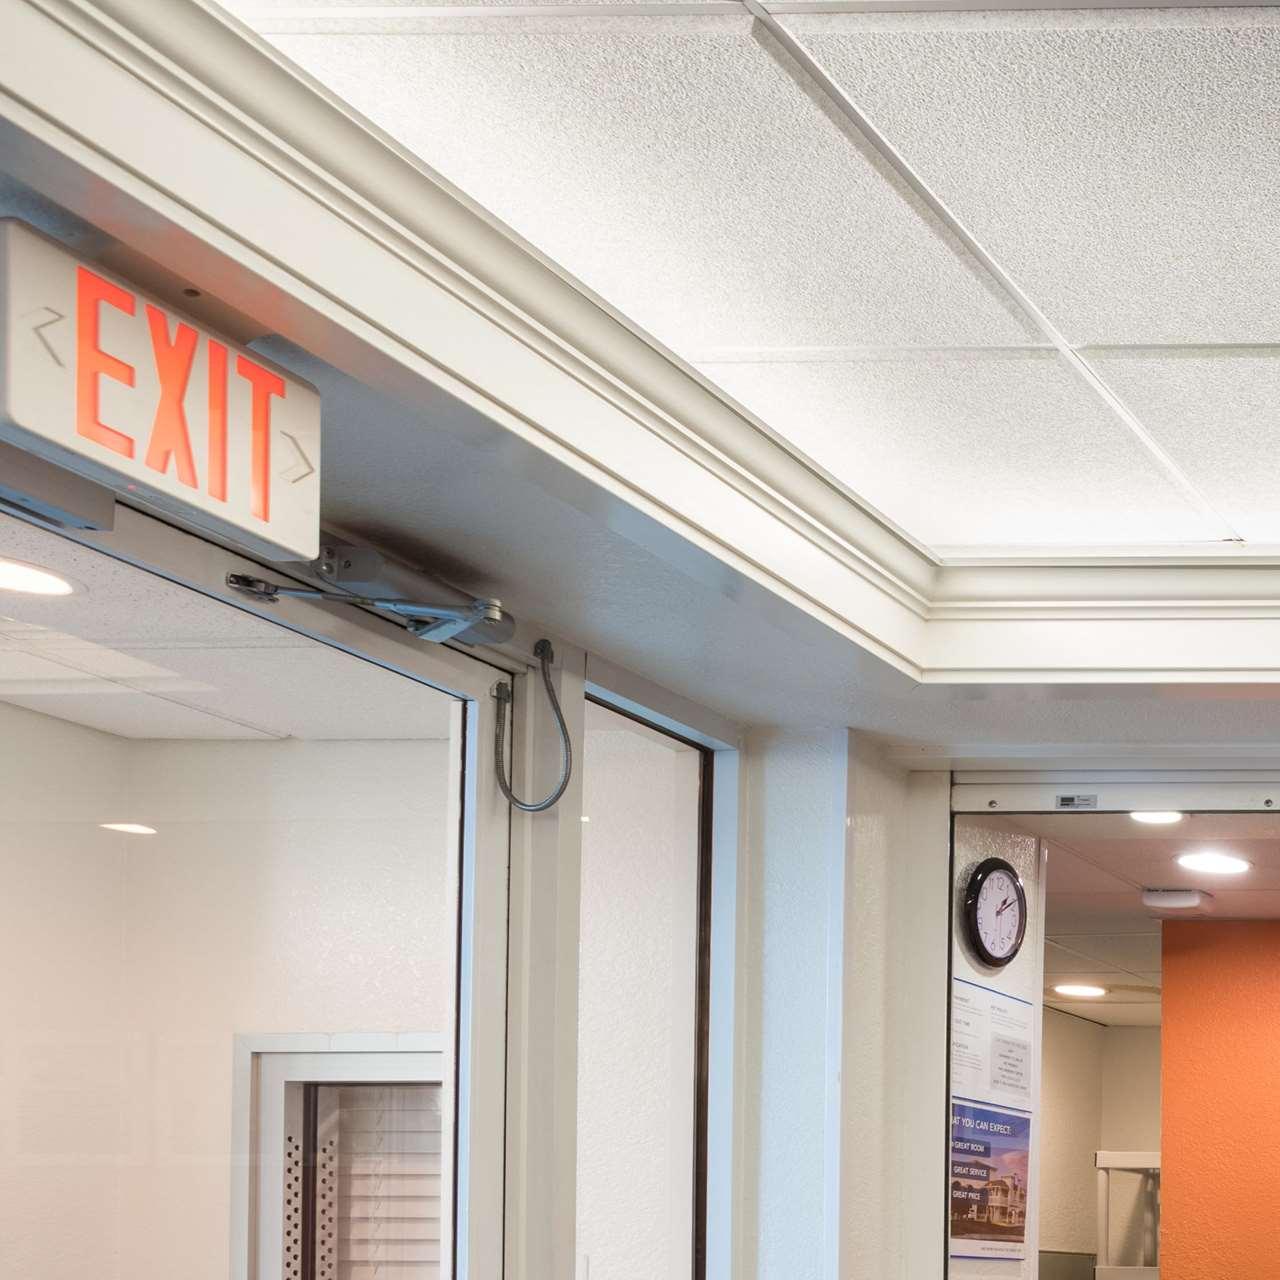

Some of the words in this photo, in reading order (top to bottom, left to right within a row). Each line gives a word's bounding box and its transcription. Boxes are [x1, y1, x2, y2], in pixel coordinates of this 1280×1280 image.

[76, 264, 287, 523] EXIT
[962, 1118, 975, 1128] YOU
[976, 1120, 989, 1130] CAN
[954, 1141, 970, 1151] GREAT
[971, 1143, 985, 1153] ROOM
[953, 1166, 969, 1175] GREAT
[969, 1168, 987, 1177] SERVICE
[952, 1190, 967, 1199] GREAT
[968, 1192, 981, 1200] PRICE
